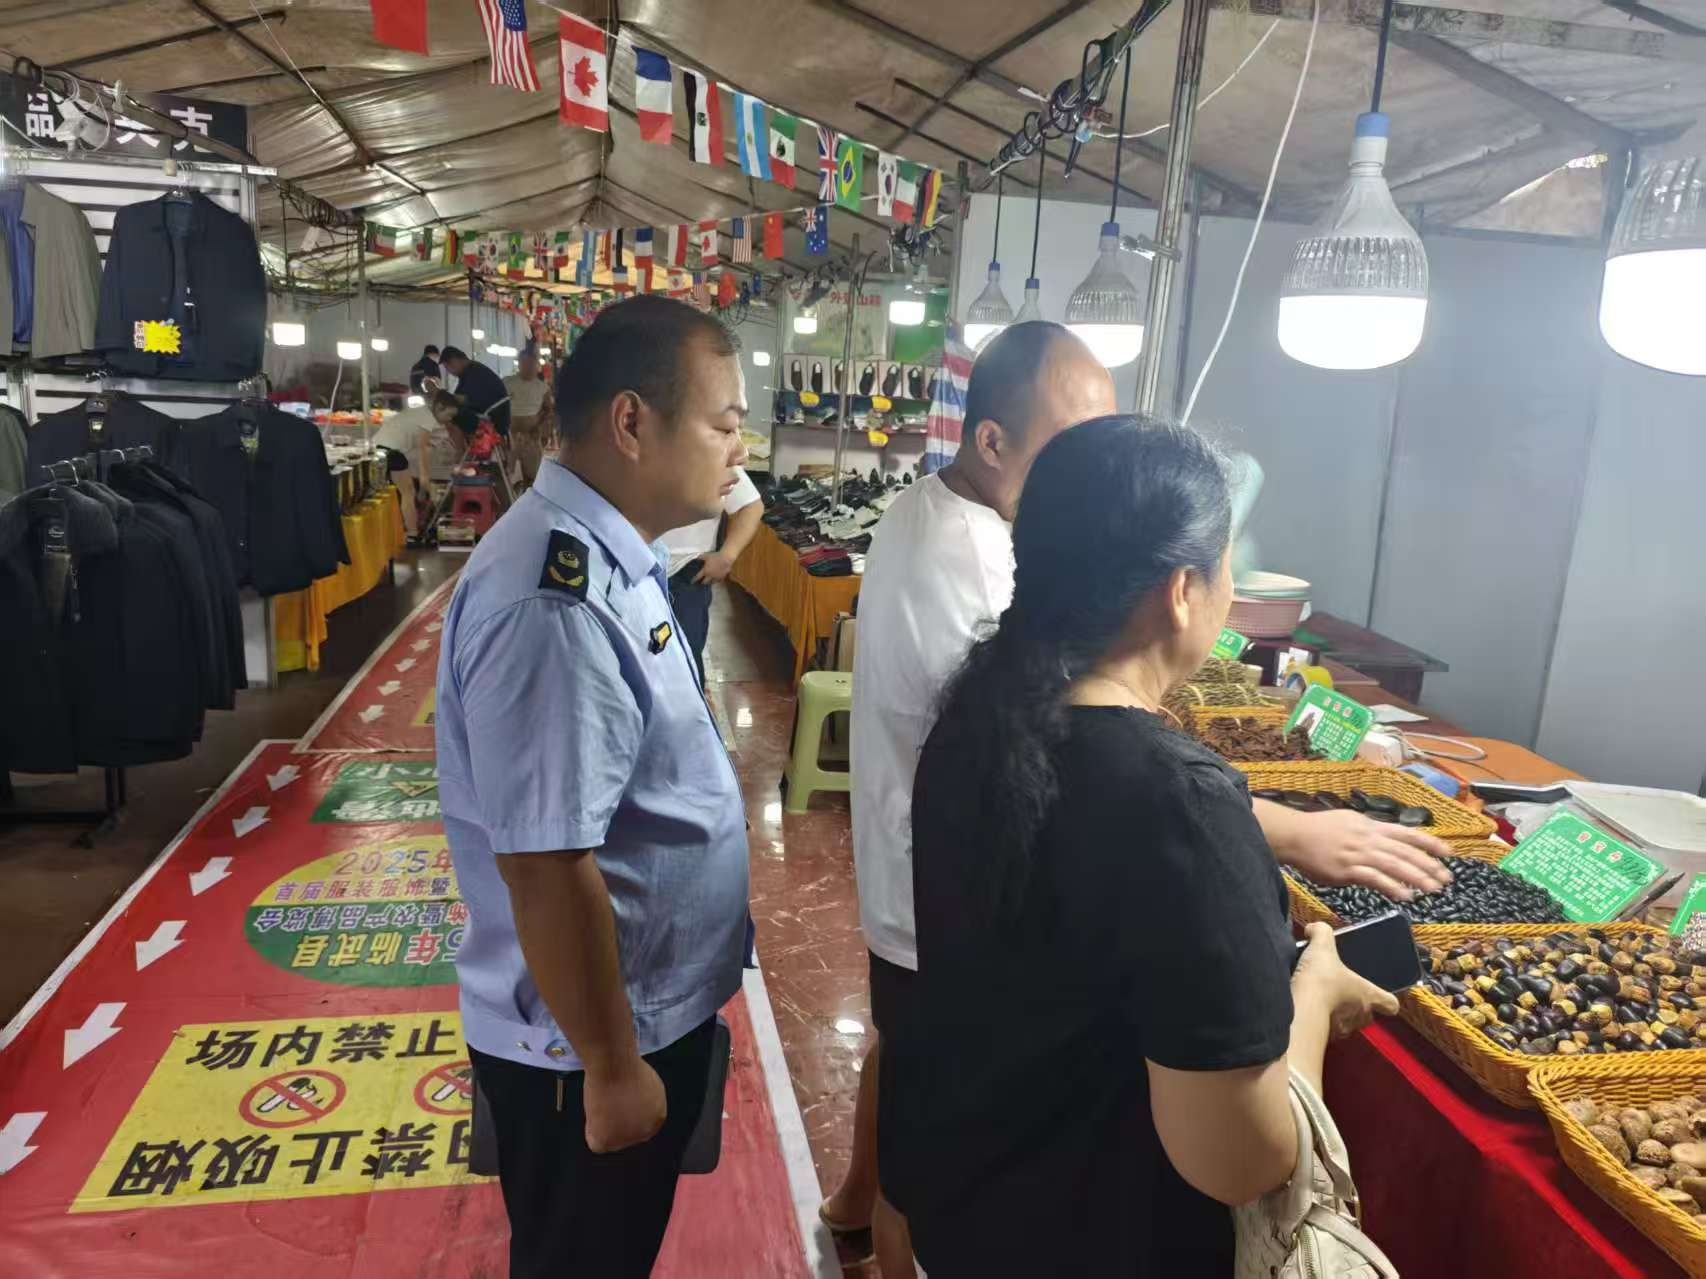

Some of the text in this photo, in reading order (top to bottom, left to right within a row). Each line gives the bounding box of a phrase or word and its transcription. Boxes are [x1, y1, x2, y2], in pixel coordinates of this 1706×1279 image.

[274, 877, 457, 901] 首届服装服饰暨
[185, 1019, 458, 1070] 场内禁止
